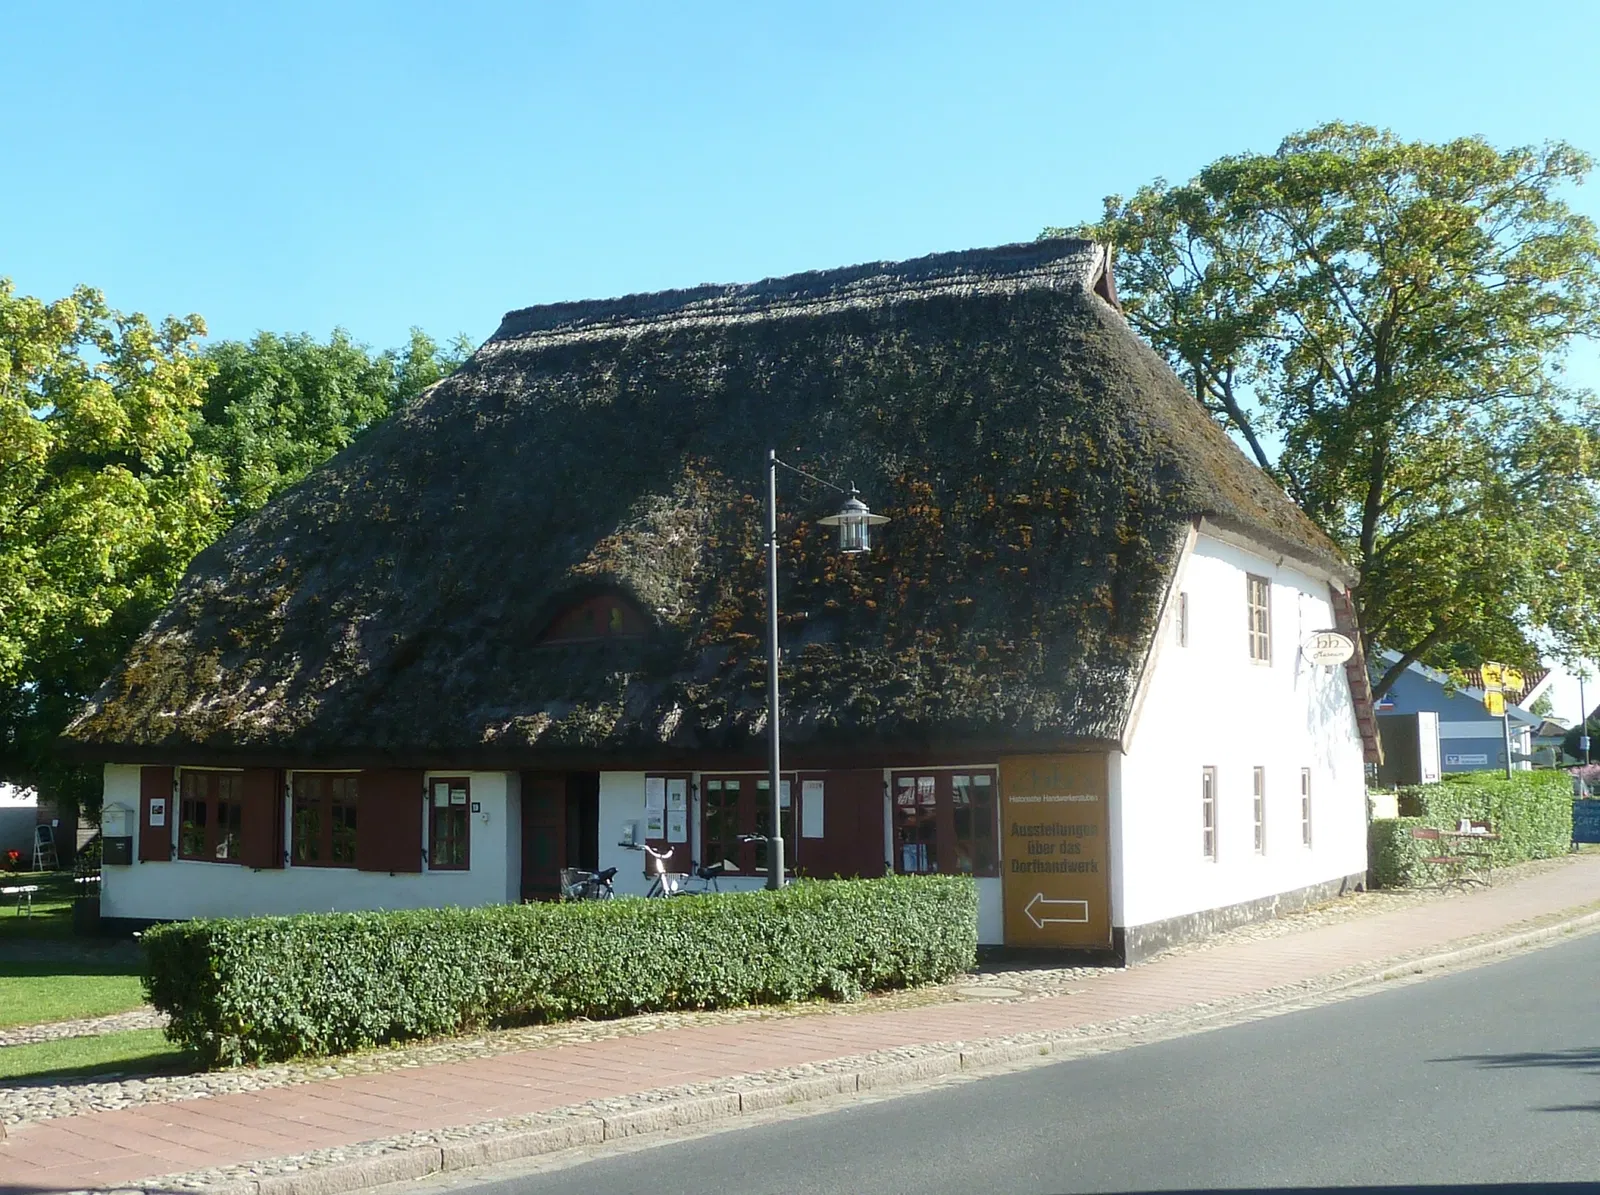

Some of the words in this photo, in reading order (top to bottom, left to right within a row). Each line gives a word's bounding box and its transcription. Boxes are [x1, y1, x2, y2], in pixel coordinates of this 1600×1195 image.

[1011, 822, 1098, 839] Ausstellungen
[1028, 840, 1056, 855] über
[1060, 840, 1081, 855] das
[1011, 858, 1099, 873] Dorfhandwerk
